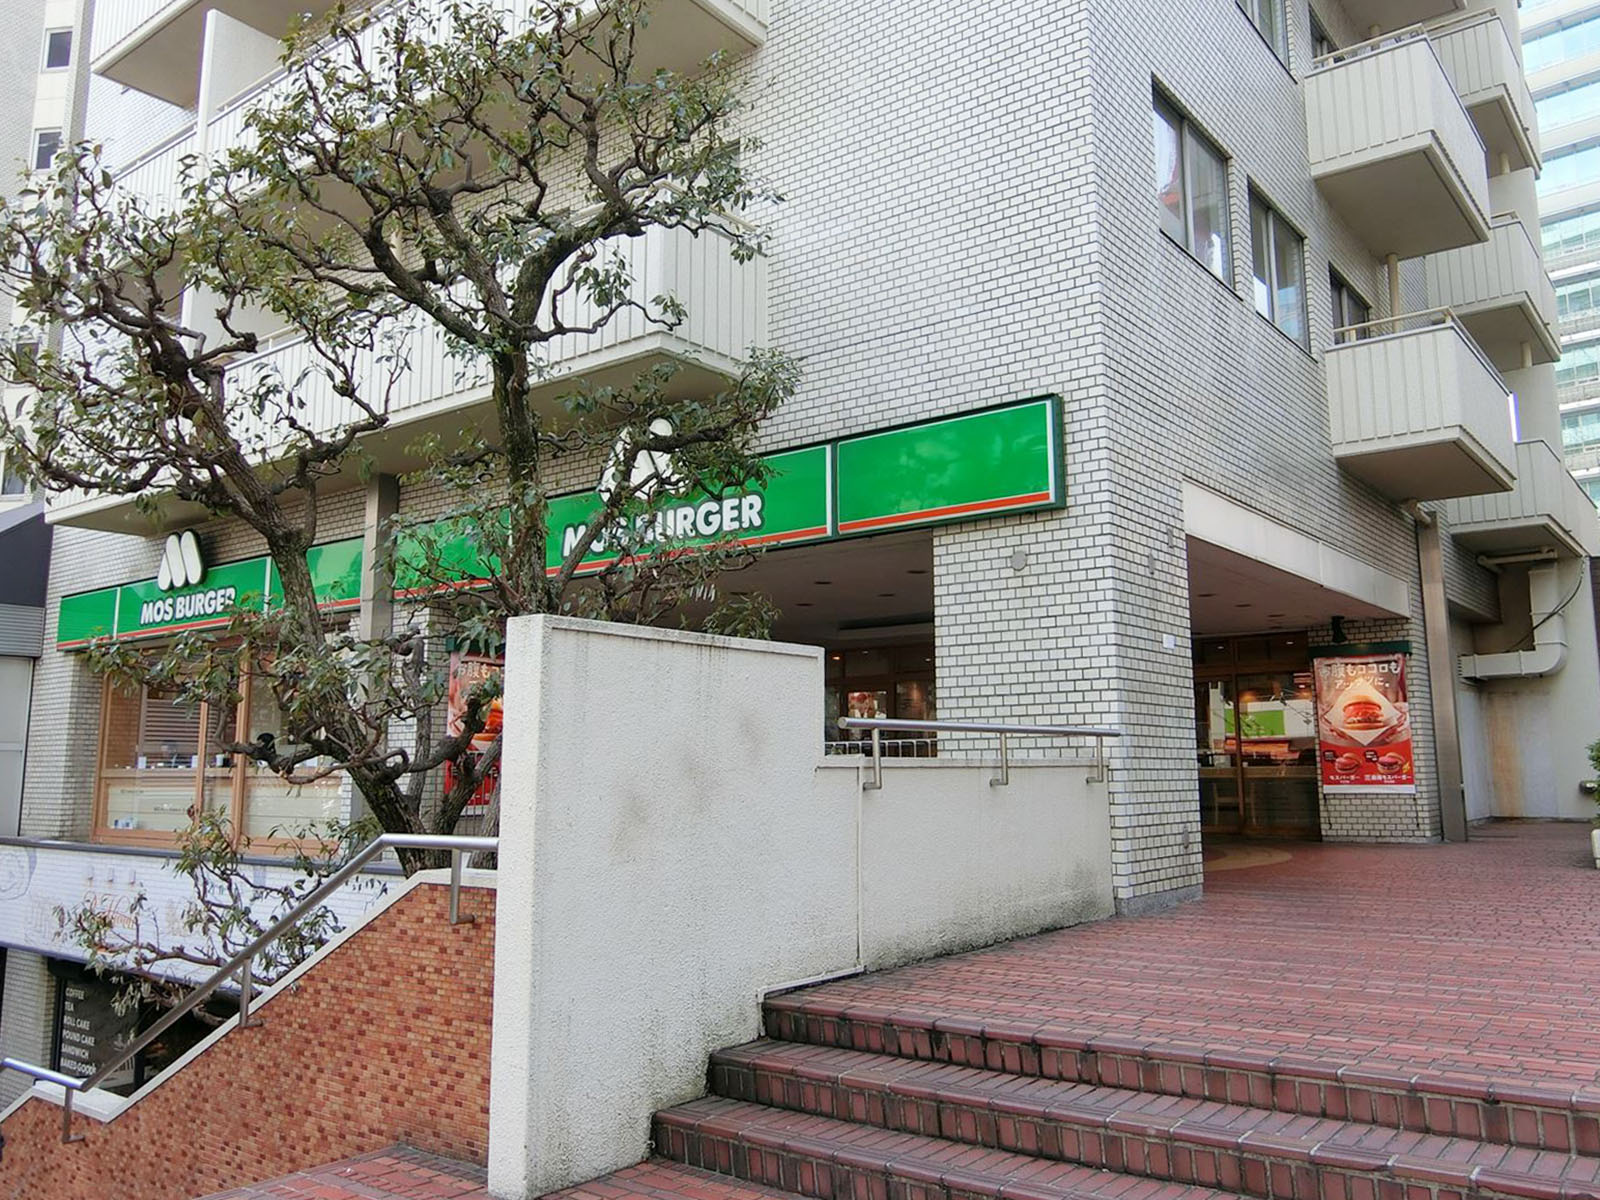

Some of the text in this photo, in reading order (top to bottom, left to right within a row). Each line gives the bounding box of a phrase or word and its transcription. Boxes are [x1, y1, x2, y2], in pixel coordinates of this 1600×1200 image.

[140, 587, 236, 625] MOS BURGER
[65, 987, 84, 1000] COFFEE
[64, 1001, 74, 1012] TEA
[76, 1018, 90, 1031] CAKE
[62, 1029, 95, 1047] POUND CAKE
[61, 1043, 89, 1059] SANDWICH
